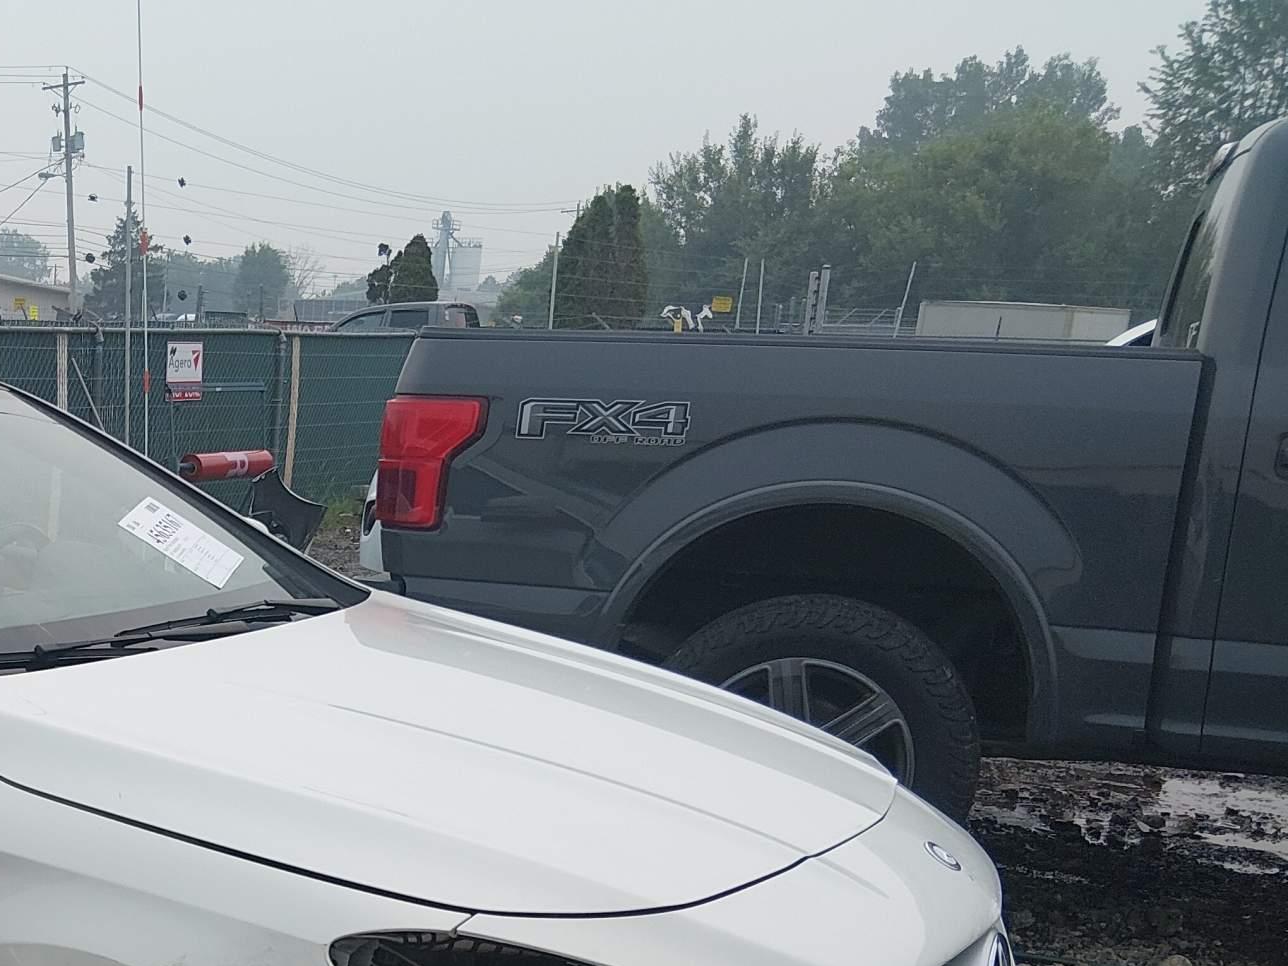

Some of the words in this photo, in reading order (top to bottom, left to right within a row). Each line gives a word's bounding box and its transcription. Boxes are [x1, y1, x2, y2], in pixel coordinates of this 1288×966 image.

[168, 357, 192, 373] Agero
[515, 397, 691, 439] FX4
[590, 434, 629, 444] OFF
[634, 436, 686, 446] ROAD
